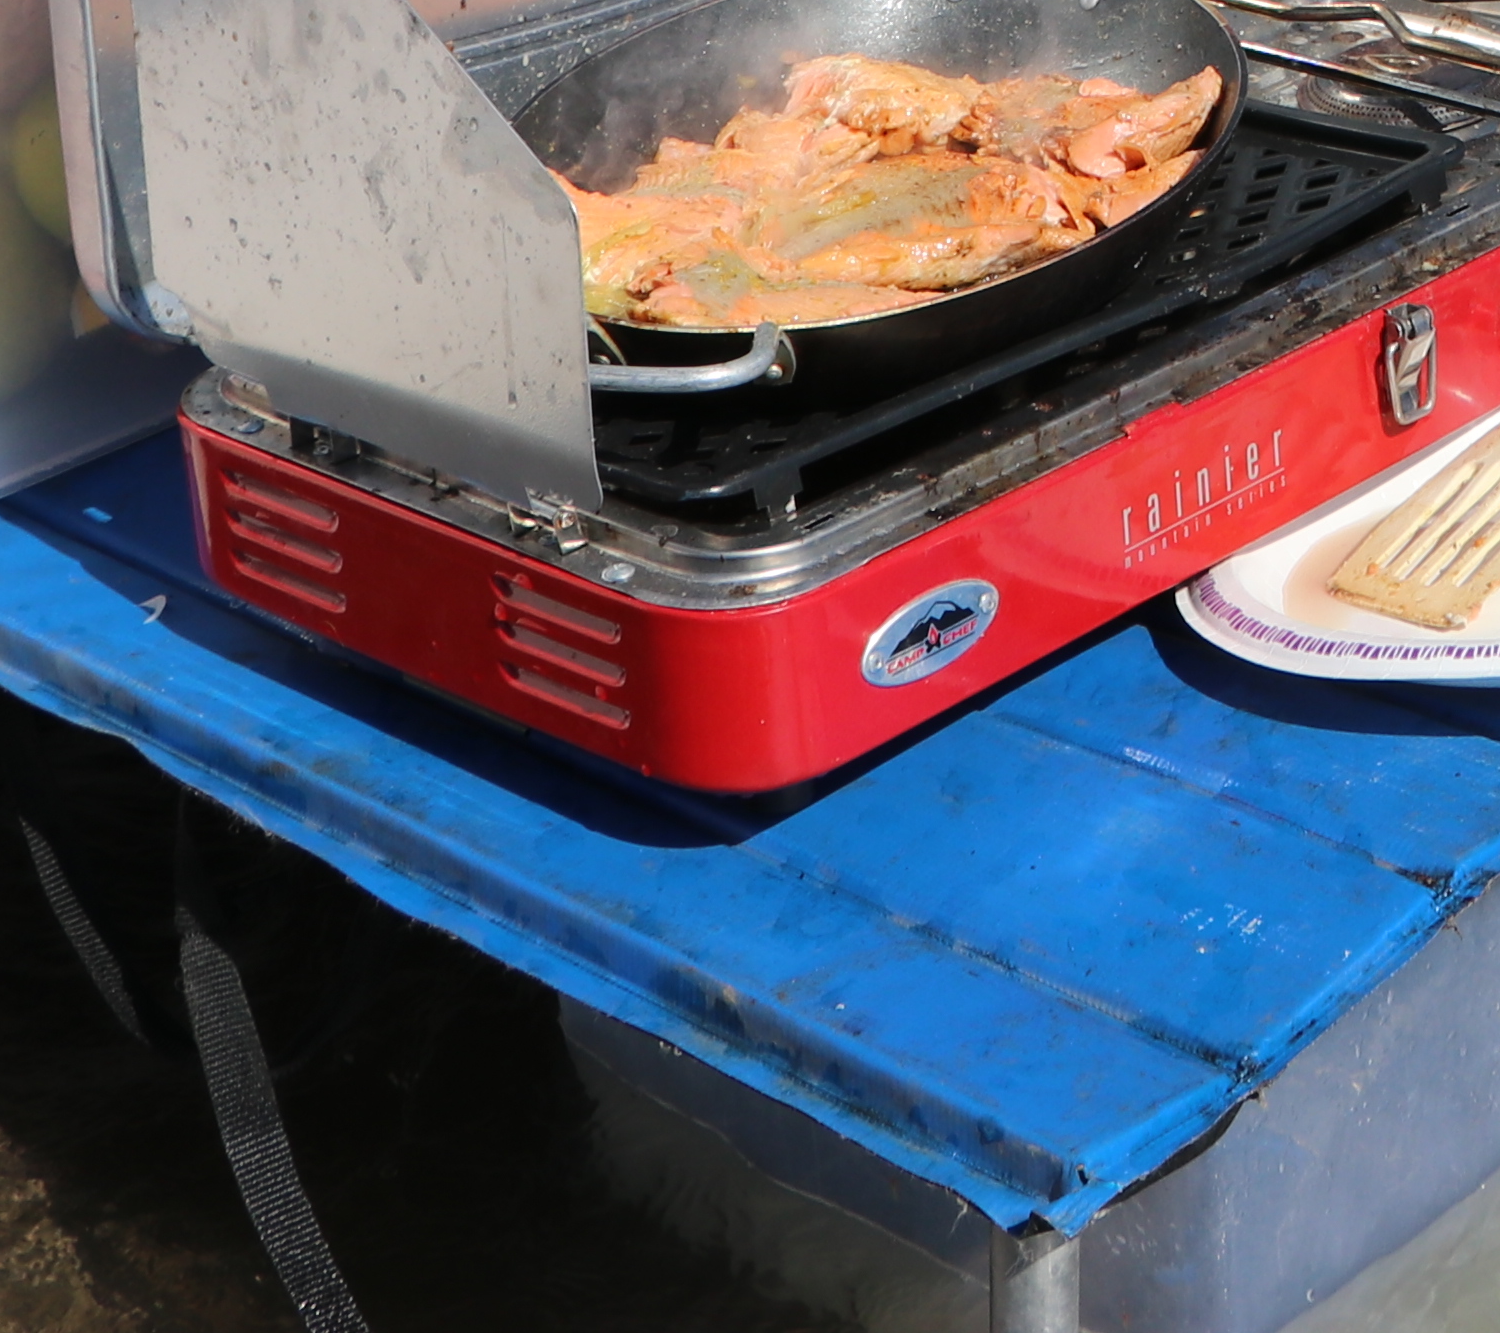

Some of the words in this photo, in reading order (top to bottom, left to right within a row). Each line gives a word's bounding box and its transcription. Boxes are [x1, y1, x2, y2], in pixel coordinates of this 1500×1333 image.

[1122, 428, 1282, 546] rainier
[1124, 513, 1211, 570] mountain
[1226, 474, 1286, 516] series
[887, 646, 925, 674] CAMP
[942, 618, 978, 645] CHEF
